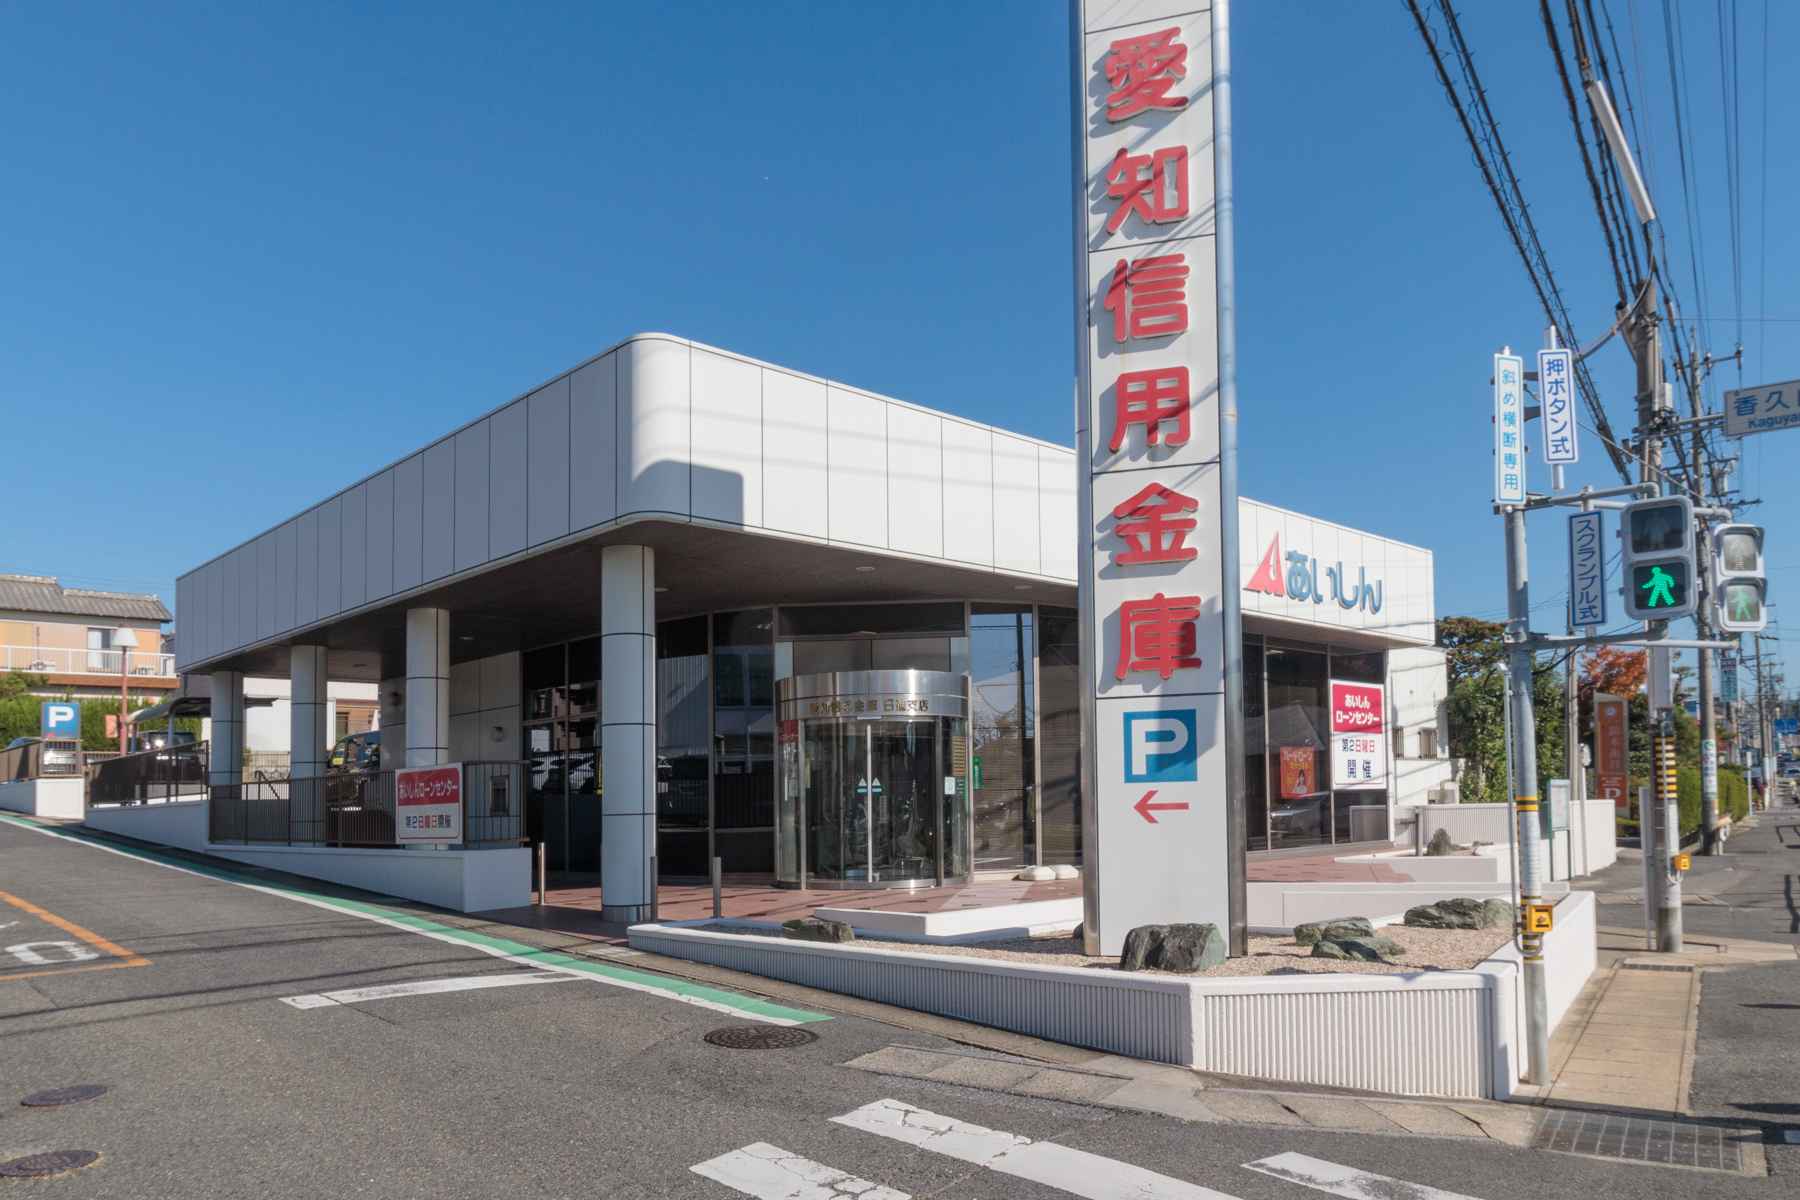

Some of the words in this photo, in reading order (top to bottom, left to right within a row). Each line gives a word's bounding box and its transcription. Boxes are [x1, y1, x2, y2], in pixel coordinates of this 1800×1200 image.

[1103, 25, 1203, 679] 愛知信用金庫
[1545, 358, 1571, 455] 押ボタン式
[1733, 389, 1800, 416] 香久
[1502, 368, 1519, 491] 斜め横断専用
[1748, 413, 1800, 429] Kaguya
[1576, 519, 1598, 620] スクランブル式
[1285, 549, 1383, 615] あいしん
[810, 699, 878, 714] 愛知信用金庫
[883, 698, 929, 712] 日進支店
[1344, 693, 1371, 709] あいしん
[49, 705, 74, 728] P
[1336, 709, 1380, 726] ローンセンター
[1132, 720, 1188, 775] P
[1341, 738, 1376, 754] 第2日曜日
[1347, 758, 1372, 780] 開催
[398, 778, 458, 800] あいしんローンセンター
[404, 813, 452, 830] 第2日曜日開催
